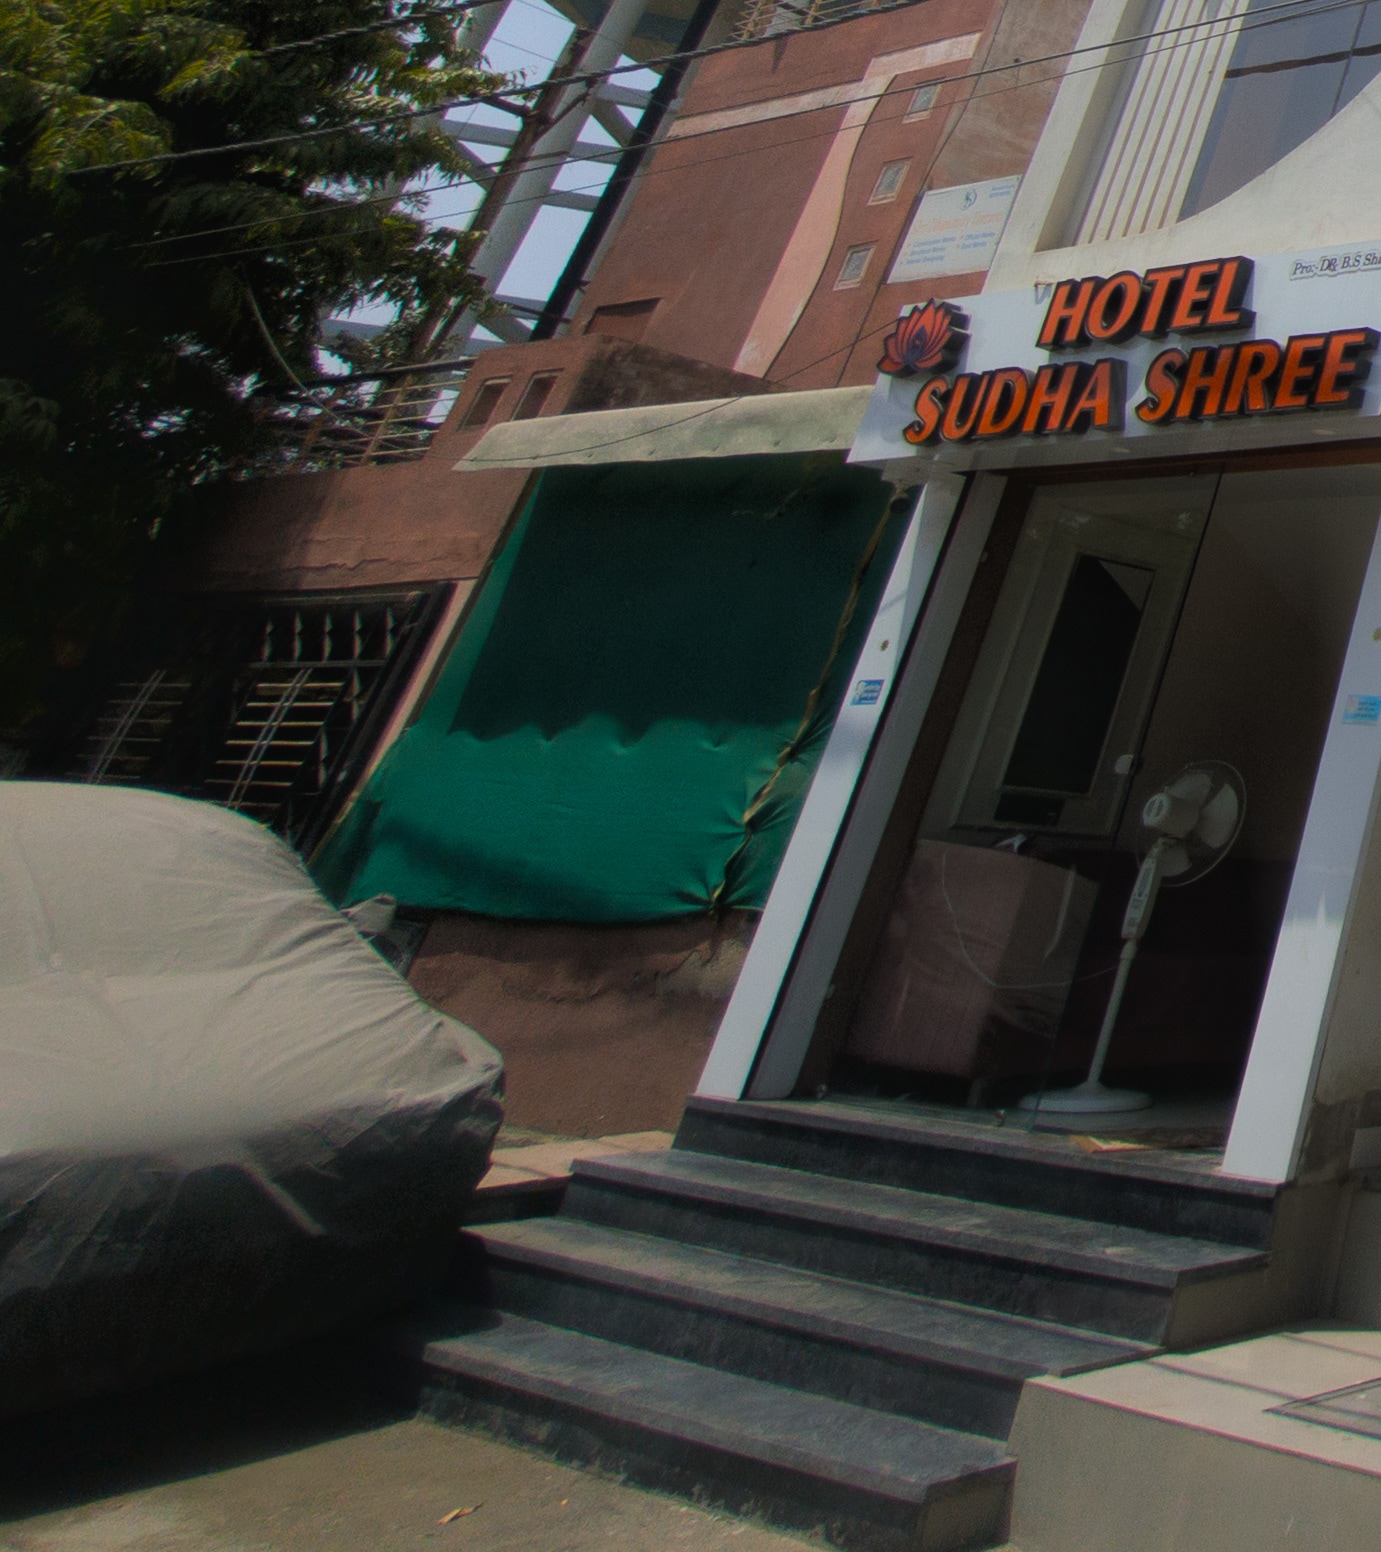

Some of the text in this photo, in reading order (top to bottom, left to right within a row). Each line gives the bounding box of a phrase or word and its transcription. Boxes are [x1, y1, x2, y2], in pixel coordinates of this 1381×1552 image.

[1038, 257, 1250, 348] HOTEL
[903, 328, 1375, 446] SUDHA SHREE
